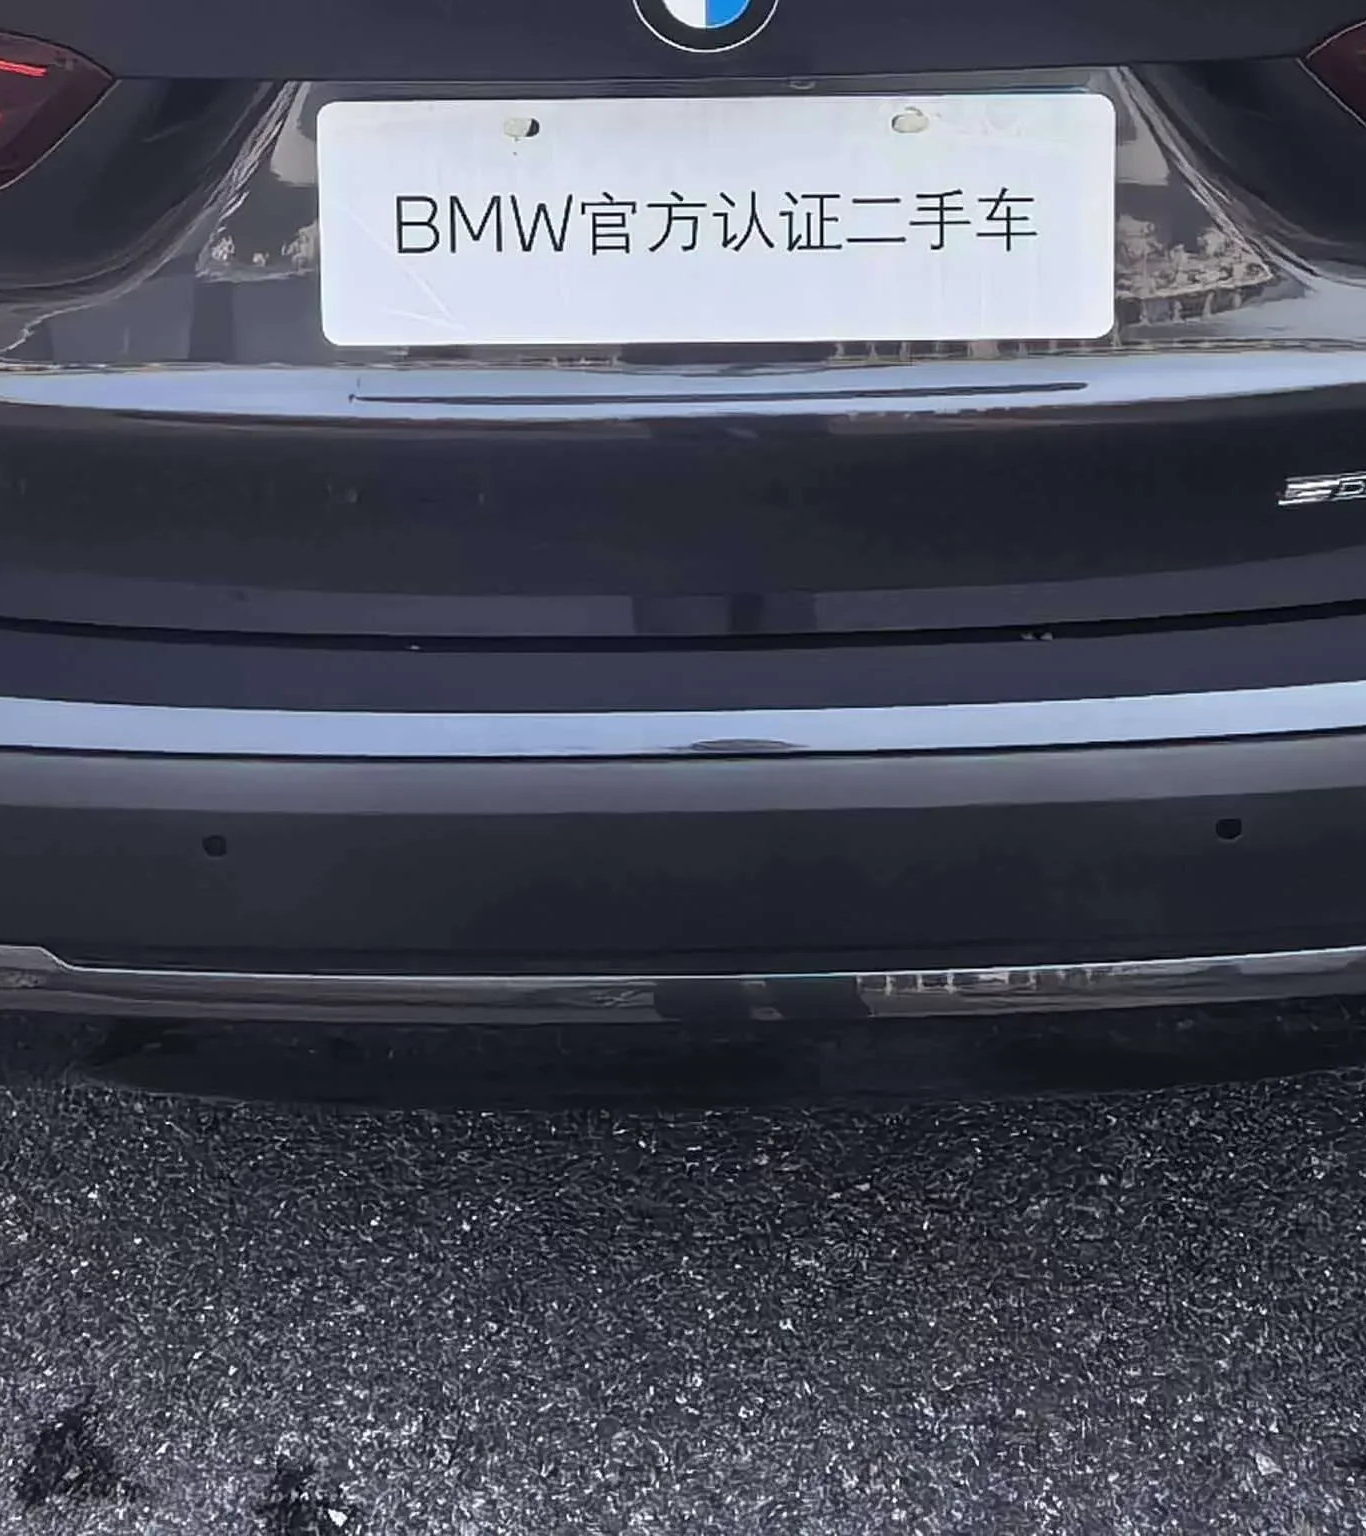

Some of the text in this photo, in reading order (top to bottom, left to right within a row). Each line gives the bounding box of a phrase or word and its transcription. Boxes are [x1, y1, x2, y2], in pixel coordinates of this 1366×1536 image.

[394, 186, 1037, 255] BMW官方认证二手车
